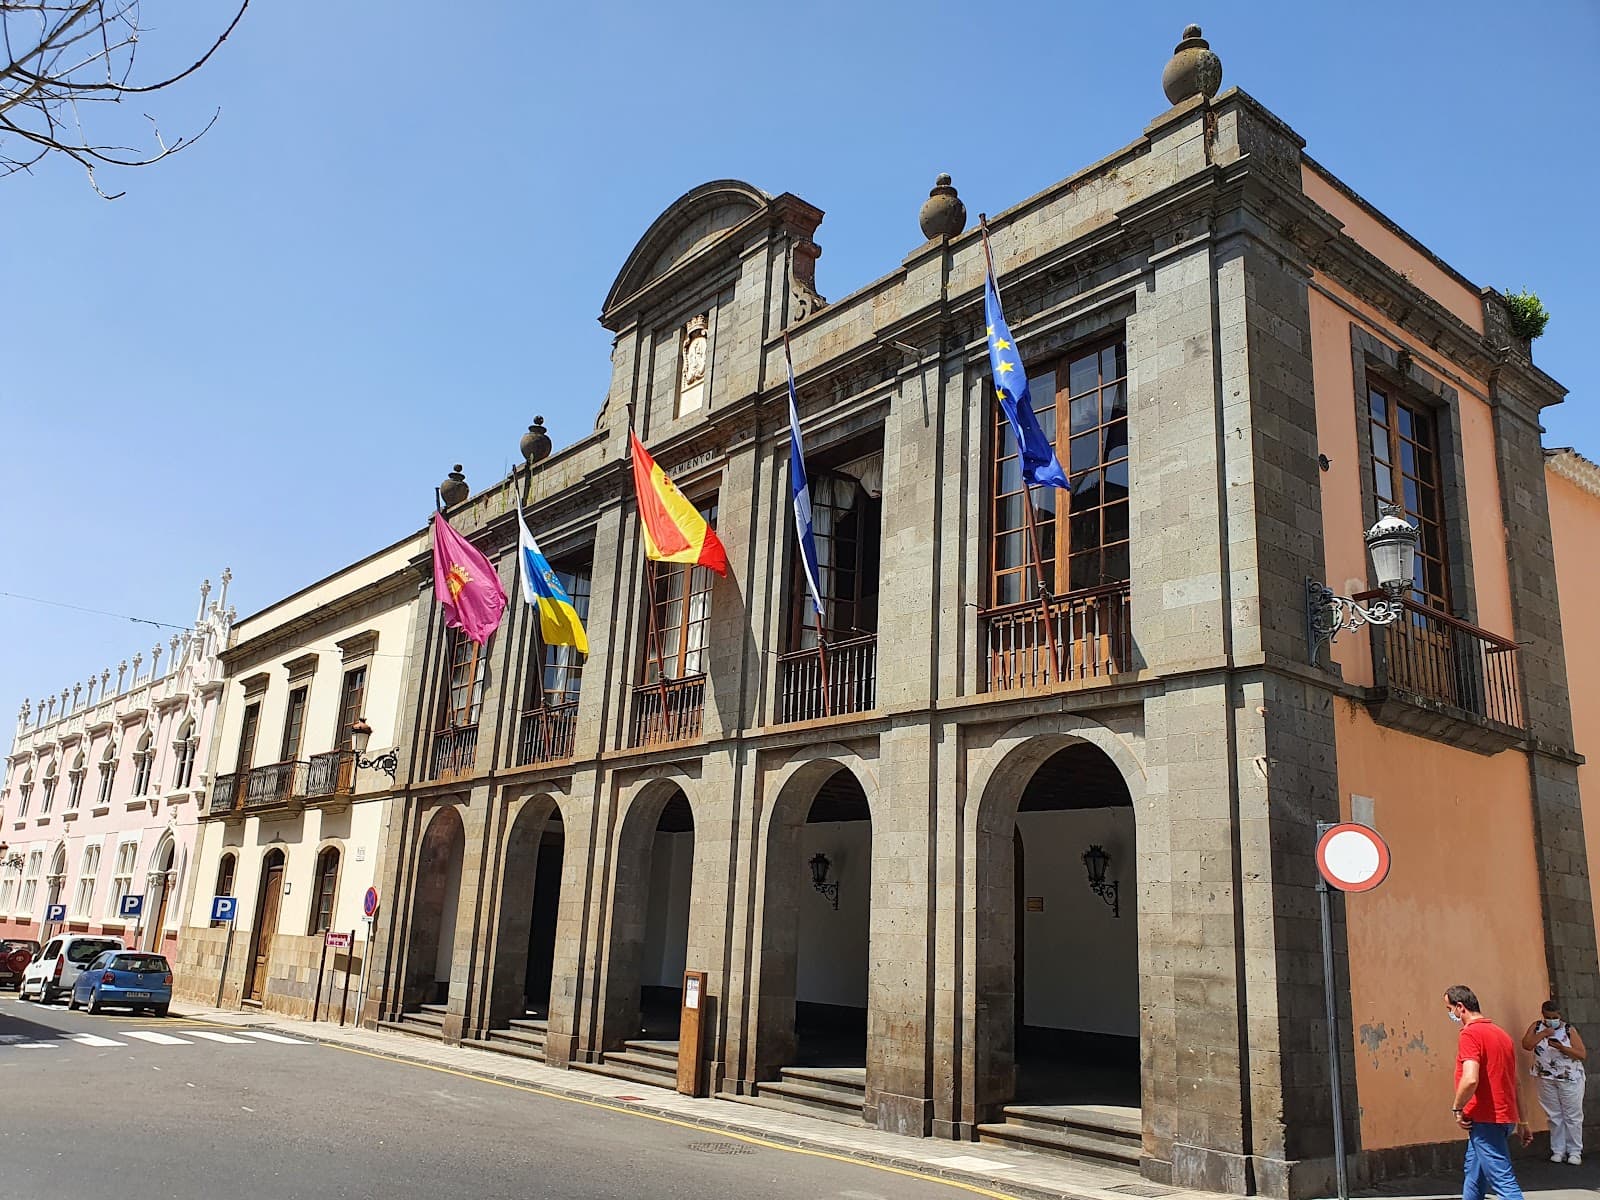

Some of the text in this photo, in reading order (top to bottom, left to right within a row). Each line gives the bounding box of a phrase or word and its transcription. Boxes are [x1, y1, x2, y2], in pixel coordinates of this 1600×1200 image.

[49, 906, 63, 920] P
[124, 897, 139, 913] P
[216, 899, 232, 918] P
